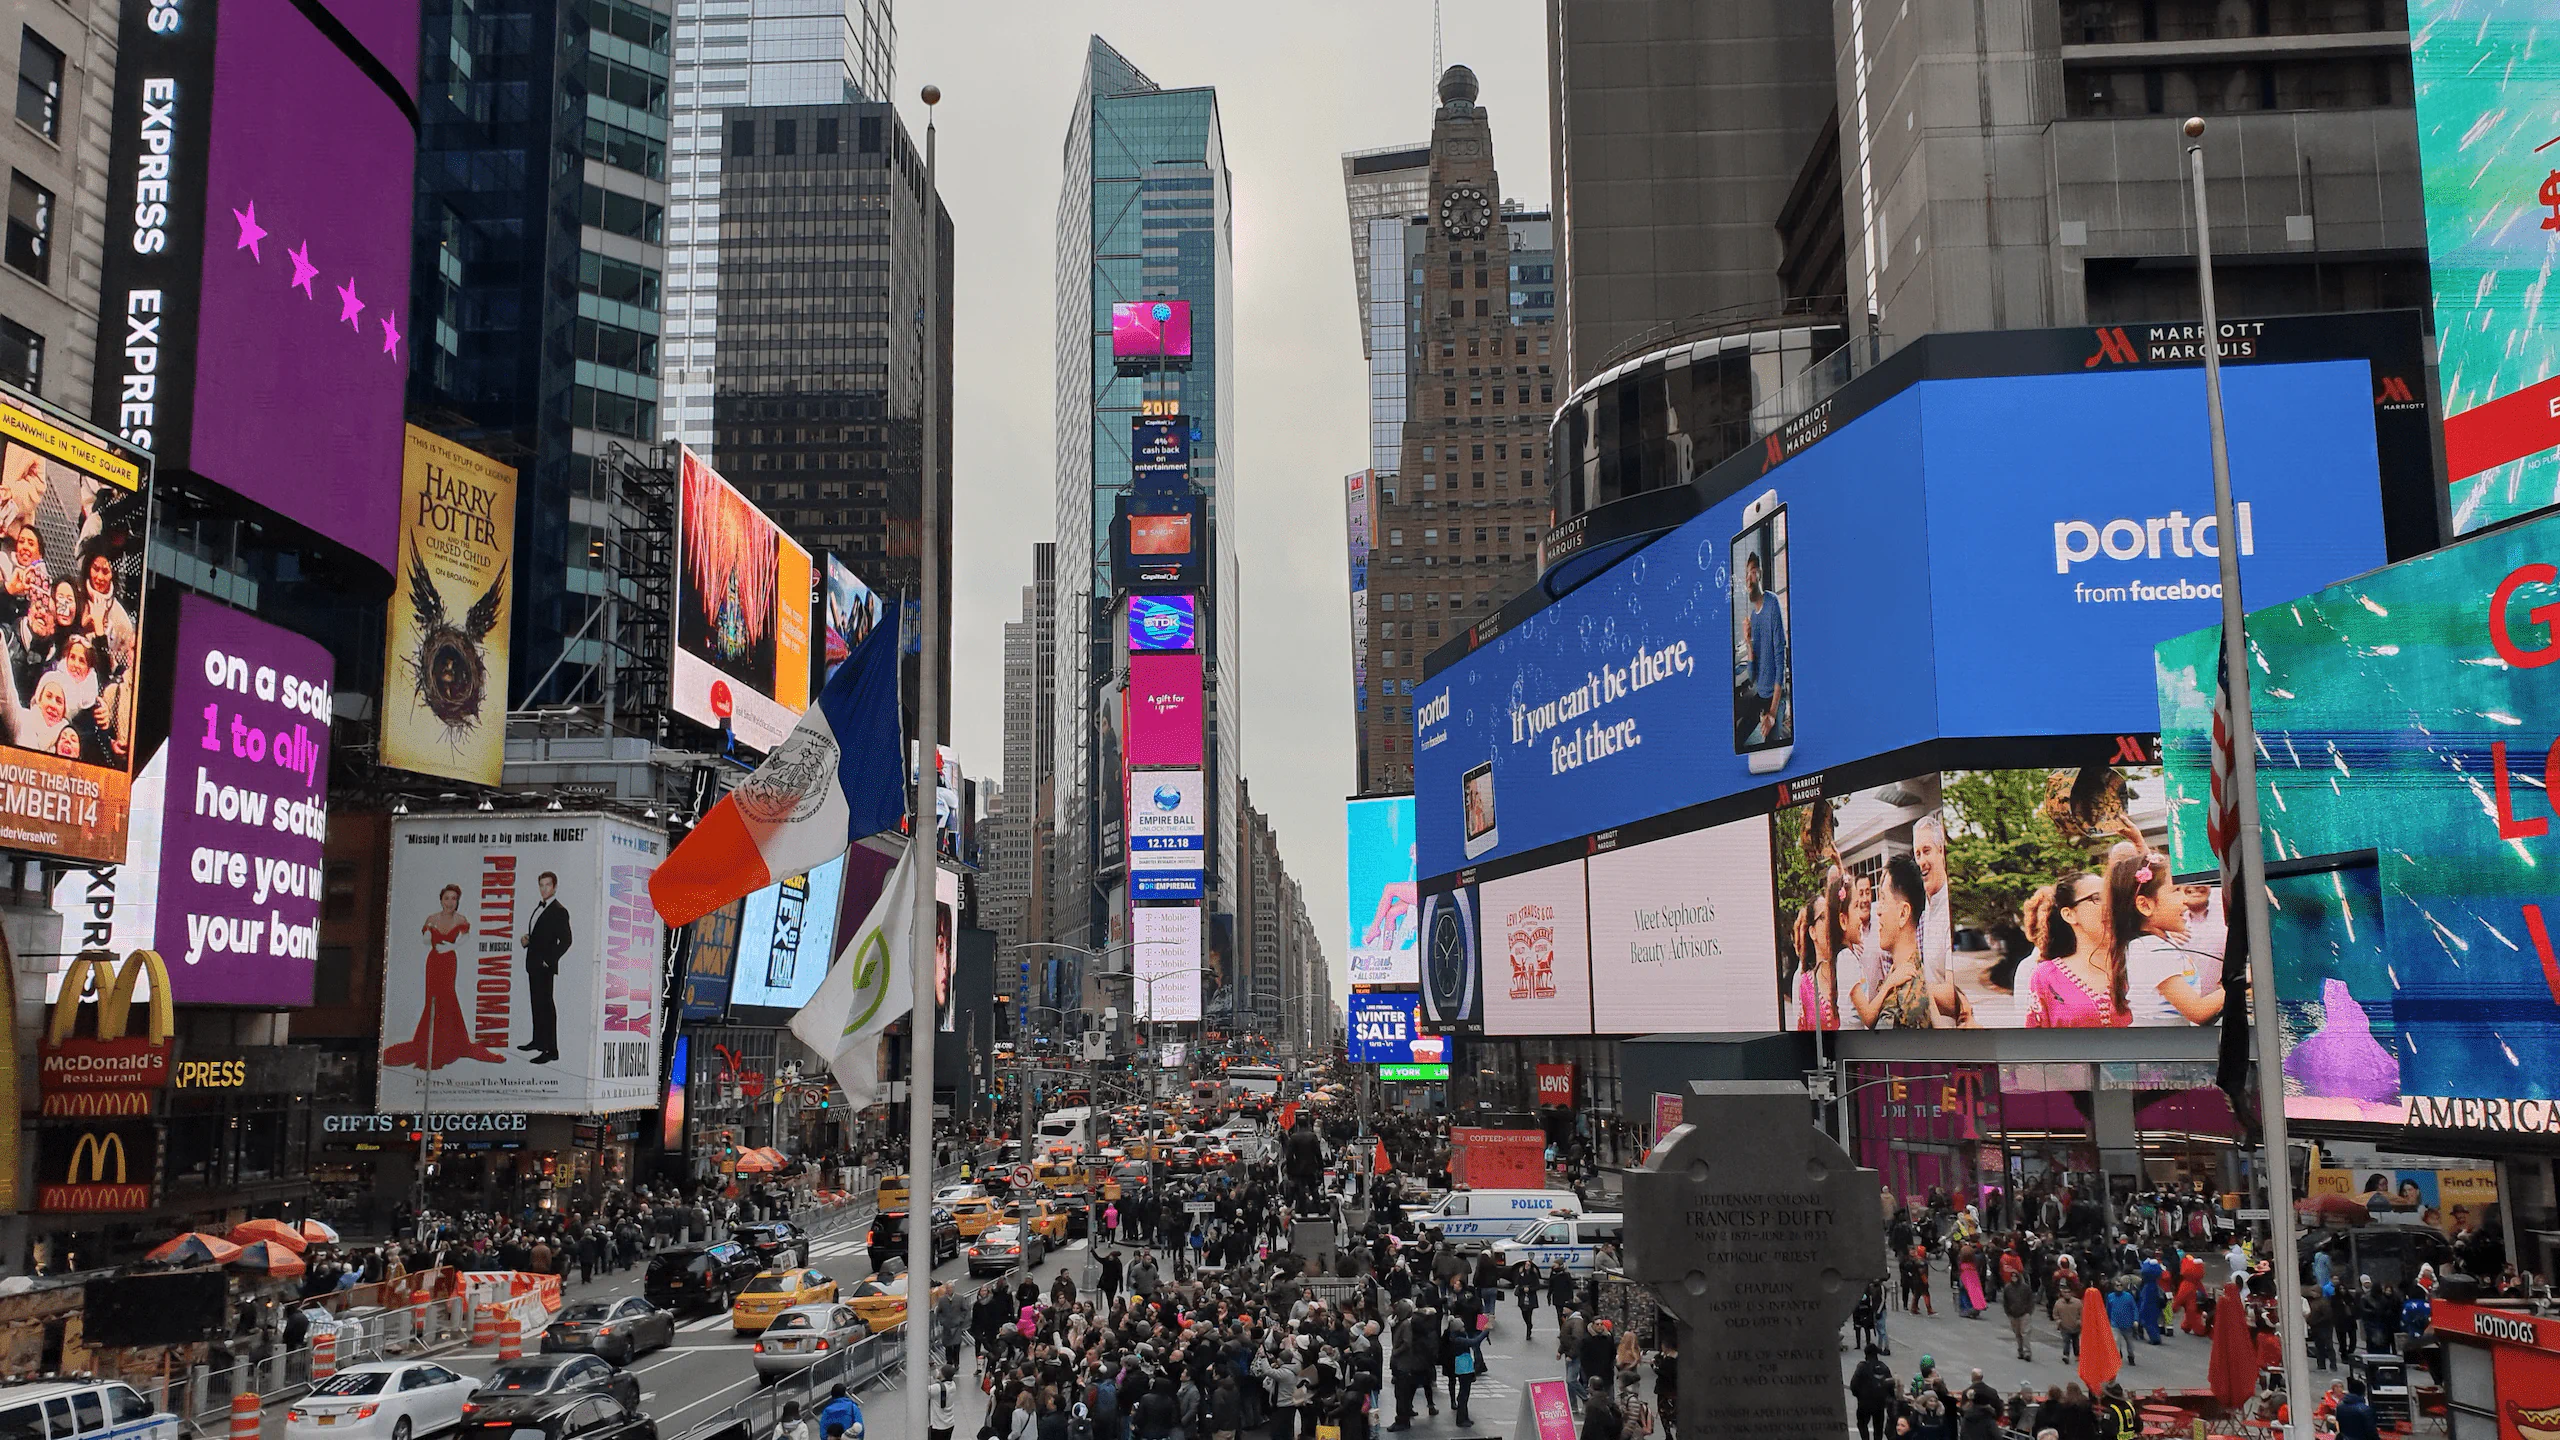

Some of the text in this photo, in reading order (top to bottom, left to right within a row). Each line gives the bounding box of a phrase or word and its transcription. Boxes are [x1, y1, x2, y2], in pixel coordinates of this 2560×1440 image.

[133, 77, 175, 255] EXPRESS
[2150, 322, 2265, 341] MARROTT
[1143, 401, 1180, 416] 2018
[2383, 402, 2425, 411] MARRIOTT
[1786, 399, 1833, 438] MARRIOTT
[2, 414, 55, 446] MEANWHILE
[58, 439, 68, 452] IN
[71, 444, 97, 464] TIMES
[1154, 437, 1168, 446] 4%
[1786, 419, 1828, 455] MARQUIS
[1142, 445, 1180, 454] cash back
[1134, 463, 1188, 472] entertainment
[425, 462, 498, 520] HARRY
[418, 491, 502, 552] POTTER
[1546, 516, 1589, 545] MARRIOTT
[426, 536, 491, 568] CURSED CHILD
[1546, 532, 1583, 560] MARQUIS
[435, 567, 479, 588] ON BROADWAY
[2074, 578, 2224, 603] from faceboo
[1154, 618, 1179, 627] TDK
[1478, 611, 1501, 630] MARRIOTT
[1478, 625, 1499, 642] MARQUIS
[205, 649, 248, 695] on
[255, 664, 277, 703] a
[1147, 693, 1185, 705] A gift for
[1511, 639, 1695, 748] If you can't be there,
[1418, 685, 1450, 738] portal
[201, 703, 320, 788] 1 to ally
[1551, 716, 1642, 776] feel there.
[0, 763, 100, 799] MOVIE THEATERS
[1791, 774, 1824, 790] MARRIOTT
[195, 766, 268, 827] how
[1792, 786, 1821, 801] MARQUIS
[77, 797, 98, 828] 14
[1139, 816, 1196, 825] EMPIRE BALL
[442, 832, 450, 844] it
[451, 832, 477, 844] would
[478, 832, 489, 844] be
[491, 834, 497, 843] a
[499, 832, 513, 845] big
[514, 831, 551, 843] mistake.
[1147, 838, 1190, 849] 12.12.18
[1597, 829, 1619, 842] MARRIOTT
[1597, 839, 1617, 851] MARQUIS
[190, 846, 306, 906] are you
[479, 856, 518, 939] PRETTY
[957, 873, 966, 911] 1500
[1506, 911, 1518, 927] LEVI
[1518, 904, 1541, 924] STRAUSS
[1633, 896, 1715, 933] Meet Sephora's
[185, 912, 265, 966] your
[478, 941, 513, 953] THE MUSICAL
[603, 864, 634, 1032] WOMAN
[1630, 934, 1722, 968] Beauty Advisors.
[1369, 971, 1387, 980] STARS
[475, 955, 513, 1049] WOMAN
[1355, 1011, 1407, 1023] WINTER
[1355, 1023, 1407, 1041] SALE
[44, 1051, 164, 1073] McDonald's
[602, 1041, 650, 1079] THE MUSICAL
[62, 1072, 142, 1084] Restaurant
[1395, 1067, 1421, 1077] YORK
[1540, 1075, 1570, 1094] Levi's
[322, 1114, 527, 1133] GIFTS LUGGAGE
[428, 1142, 460, 1150] SNY
[1469, 1134, 1504, 1143] COFFEED
[556, 1163, 569, 1187] ATM
[2443, 1177, 2473, 1188] Find
[1511, 1199, 1553, 1209] POLICE
[1694, 1194, 1822, 1206] LIEUTENANT COLONEL
[1445, 1222, 1479, 1233] NYPD
[1686, 1210, 1836, 1227] FRANCIS DUFFY
[1694, 1231, 1718, 1242] MAY
[1542, 1251, 1580, 1264] NYPD
[1706, 1251, 1818, 1264] CATHOLIC PRIEST
[1734, 1282, 1793, 1294] CHAPLAIN
[1768, 1300, 1822, 1312] INFANTRY
[1725, 1317, 1750, 1328] OLD
[2473, 1314, 2534, 1344] HOTDOGS
[1776, 1349, 1825, 1361] SERVICE
[1772, 1374, 1830, 1385] COUNTRY
